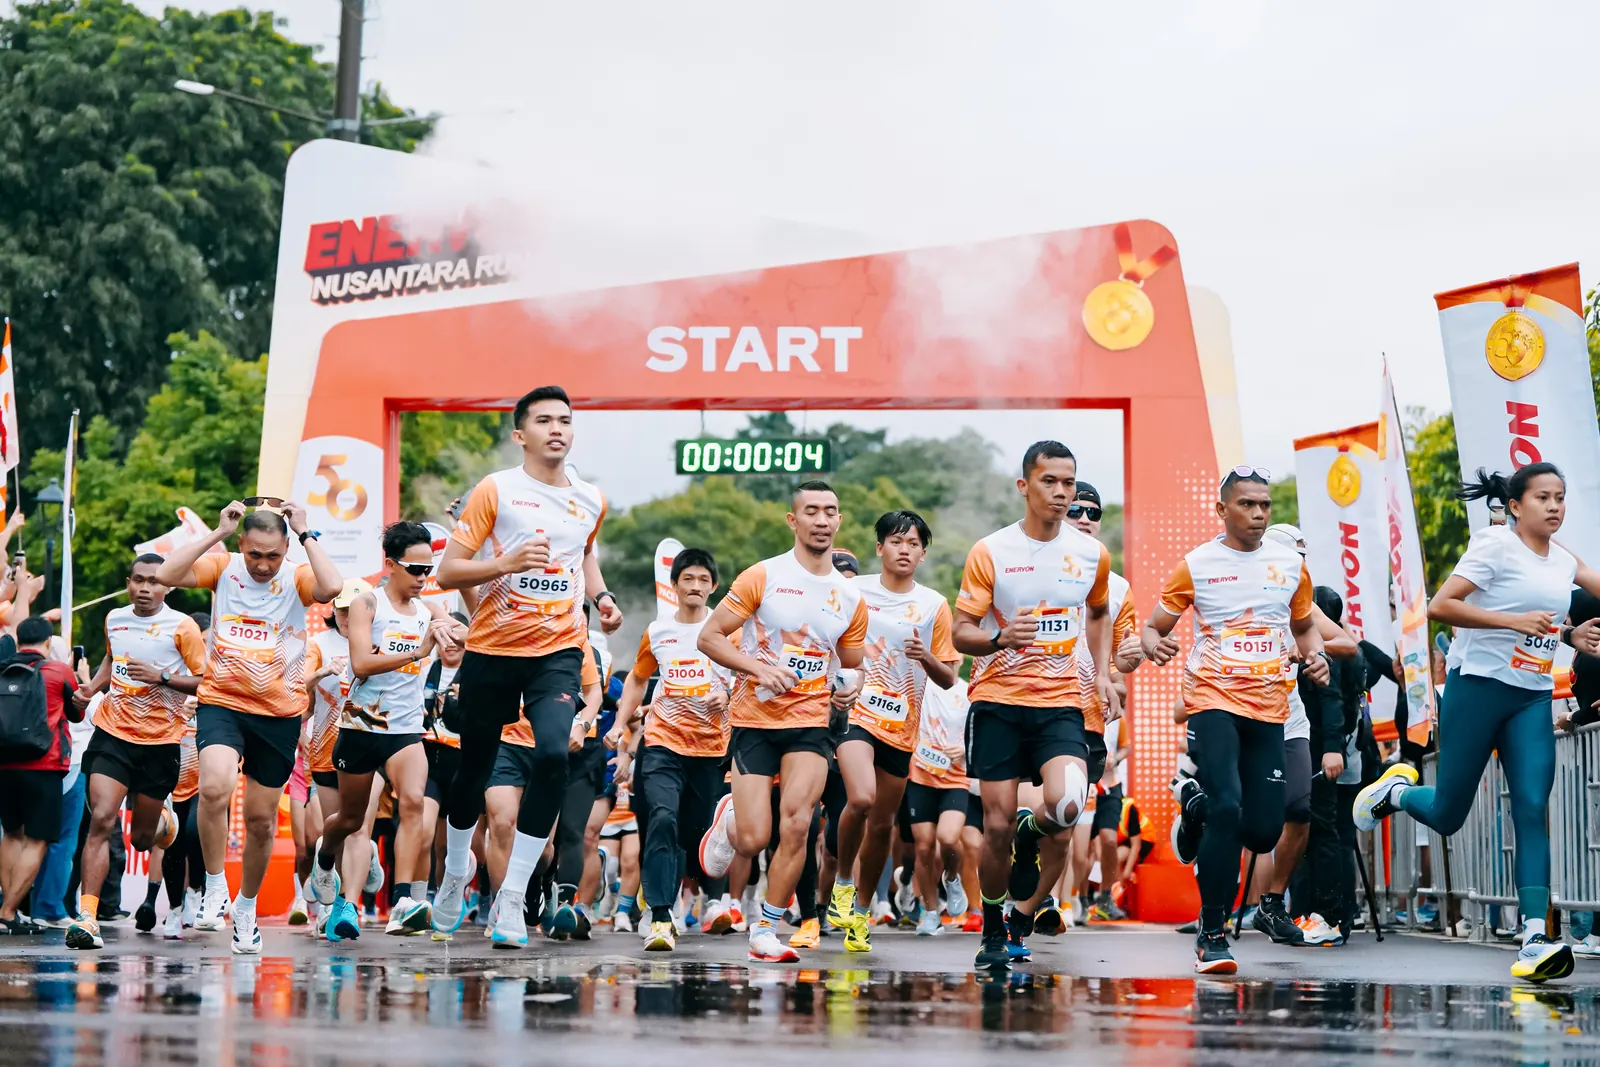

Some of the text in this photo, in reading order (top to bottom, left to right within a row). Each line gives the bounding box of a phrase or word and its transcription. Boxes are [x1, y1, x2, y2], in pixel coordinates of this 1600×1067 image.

[312, 252, 512, 299] NUSANTARA RU
[645, 326, 863, 373] START
[682, 442, 824, 472] 00:00:04
[307, 454, 368, 521] 50
[512, 500, 540, 509] ENERVON
[1005, 565, 1035, 573] ENERVON
[519, 577, 569, 592] 50965
[1208, 576, 1238, 584] ENERVON
[776, 587, 804, 596] ENERVON
[230, 626, 268, 642] 51021
[1233, 641, 1273, 652] 50151
[1524, 635, 1557, 651] 5045
[787, 657, 824, 672] 50152
[668, 669, 705, 678] 51004
[868, 695, 902, 714] 51164
[919, 748, 947, 765] 52330
